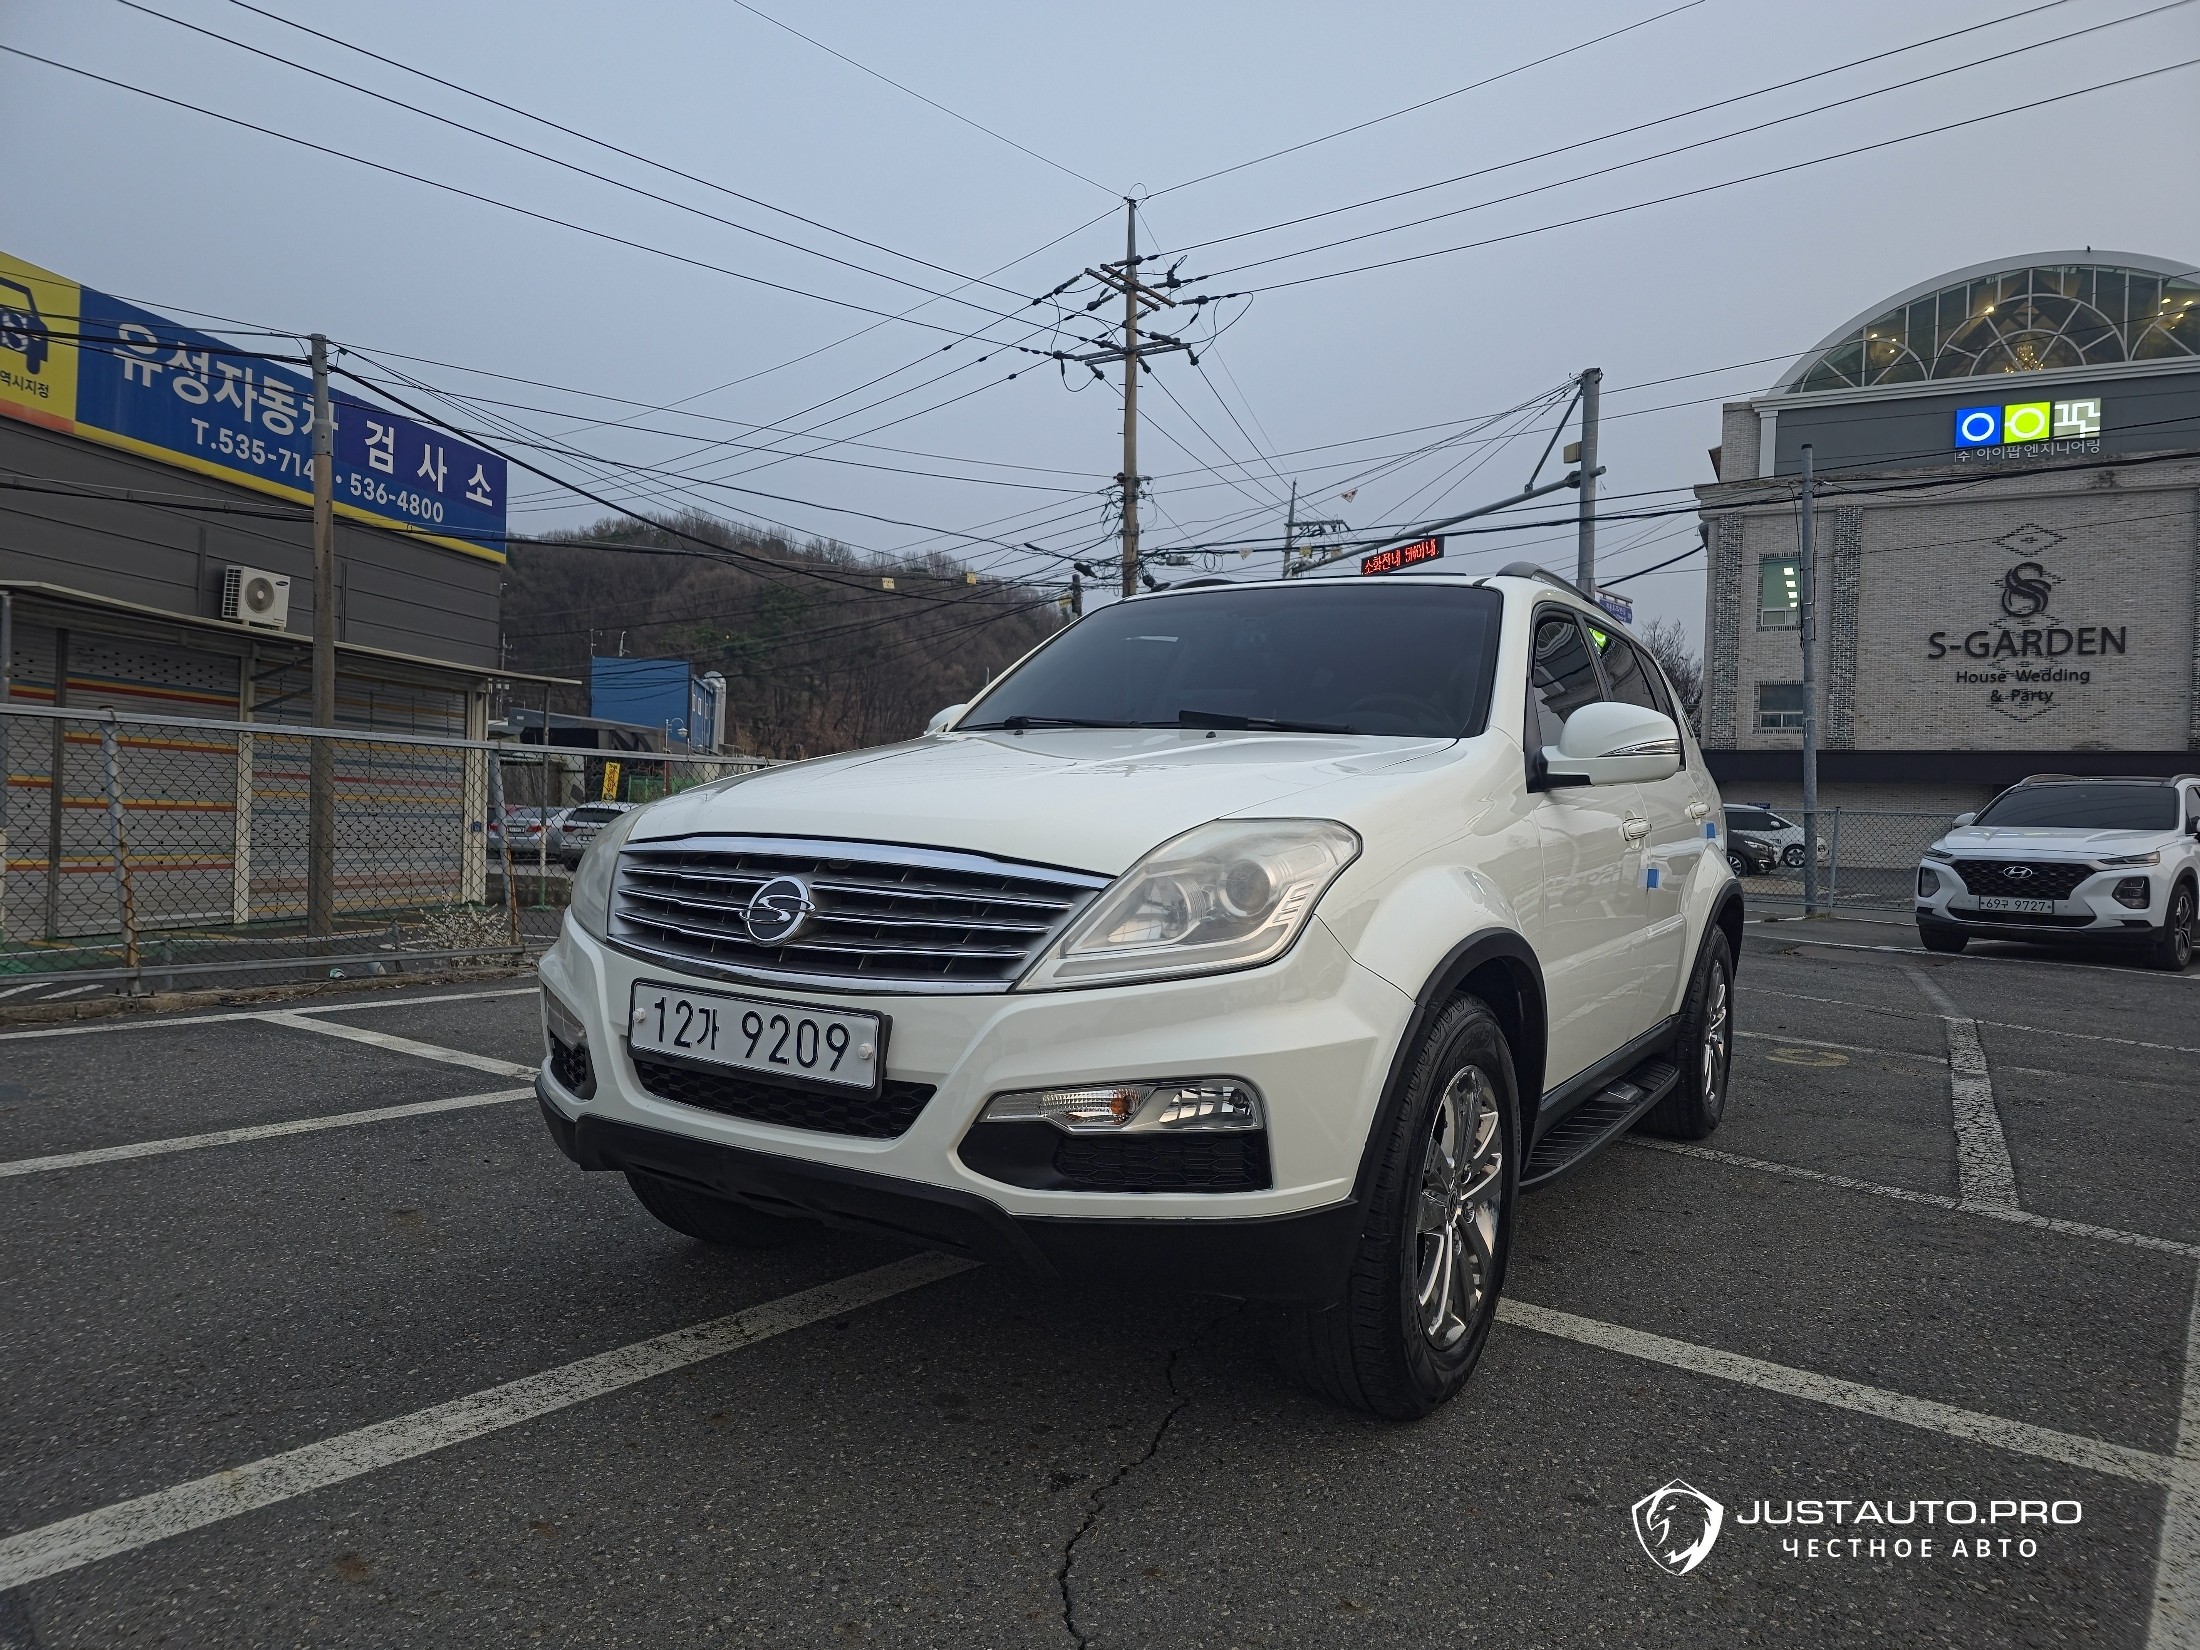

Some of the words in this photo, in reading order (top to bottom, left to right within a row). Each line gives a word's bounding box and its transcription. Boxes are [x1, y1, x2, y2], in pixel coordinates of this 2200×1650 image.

[191, 418, 315, 482] T.535-714
[350, 472, 444, 523] 536-4800
[1928, 626, 2126, 659] S-GARDEN
[1956, 670, 2007, 684] House
[2015, 668, 2090, 684] Wedding
[2011, 689, 2054, 704] Party
[2014, 900, 2046, 912] 9727
[654, 996, 720, 1051] 12가
[741, 1010, 851, 1072] 9209
